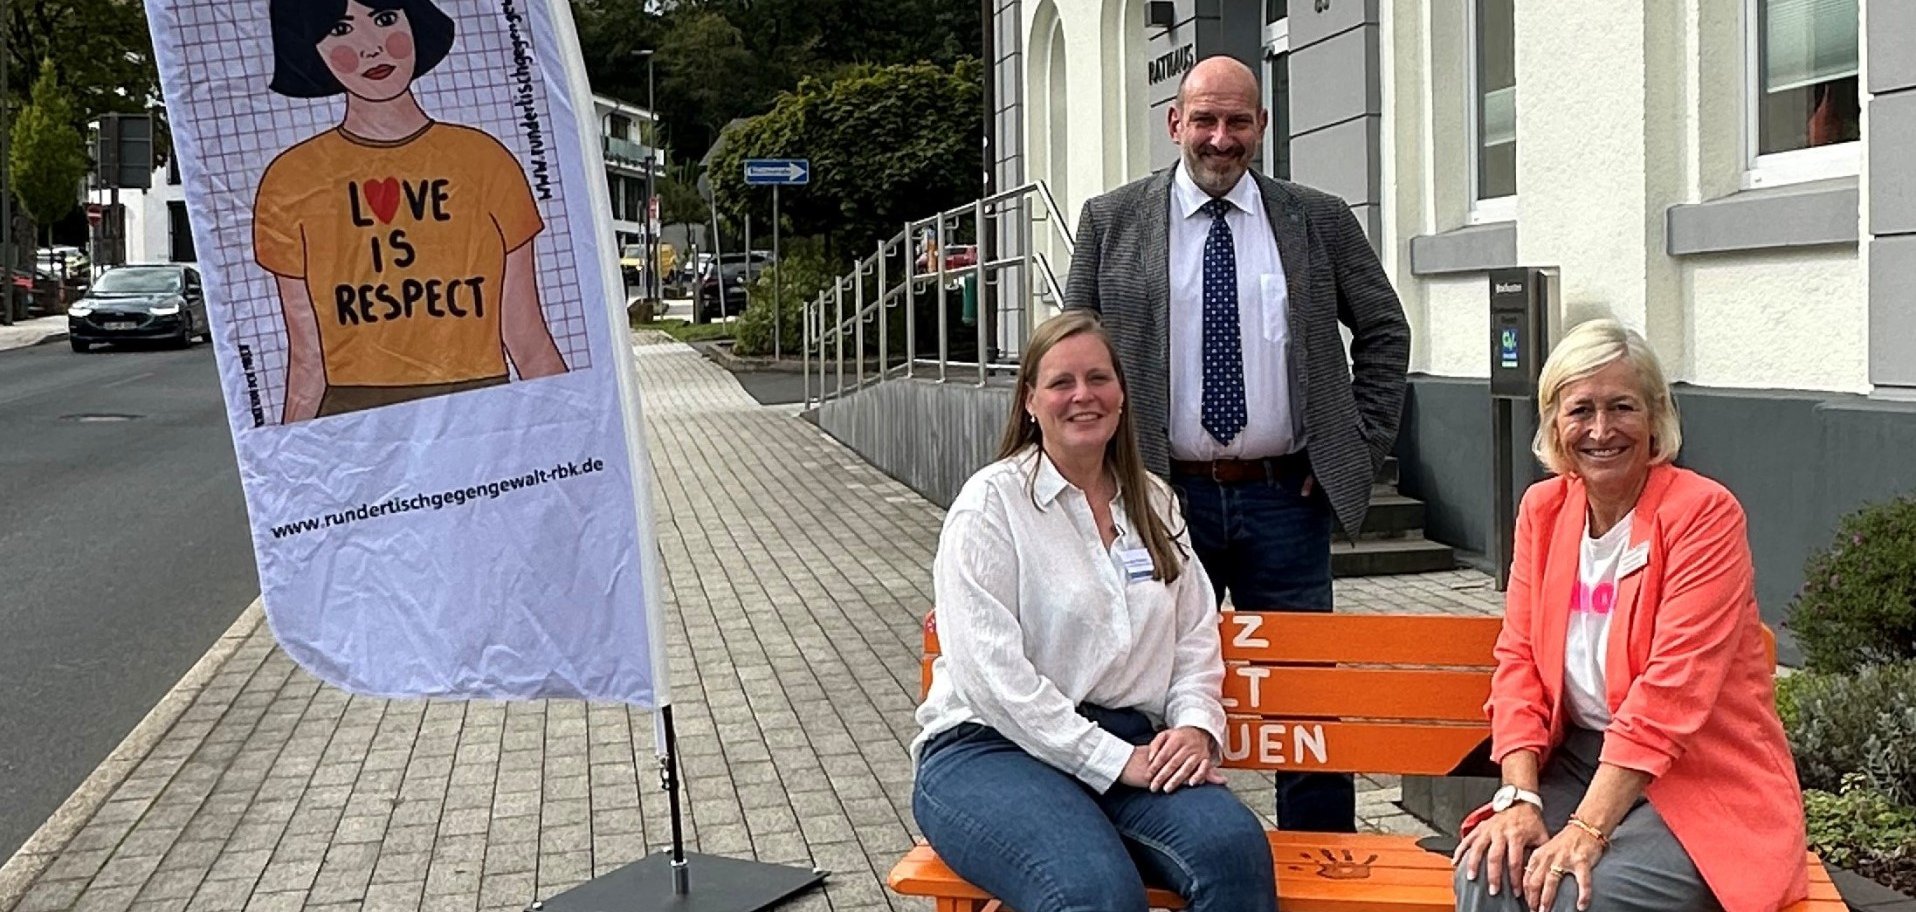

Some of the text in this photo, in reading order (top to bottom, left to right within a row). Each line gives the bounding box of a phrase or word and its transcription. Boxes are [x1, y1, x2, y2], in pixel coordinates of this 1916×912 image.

[1149, 43, 1193, 85] RATHAUS
[371, 229, 415, 273] IS
[335, 276, 485, 325] RESPECT
[271, 457, 604, 539] www.rundertischgegengewalt-rbk.de
[1218, 613, 1270, 648] Z
